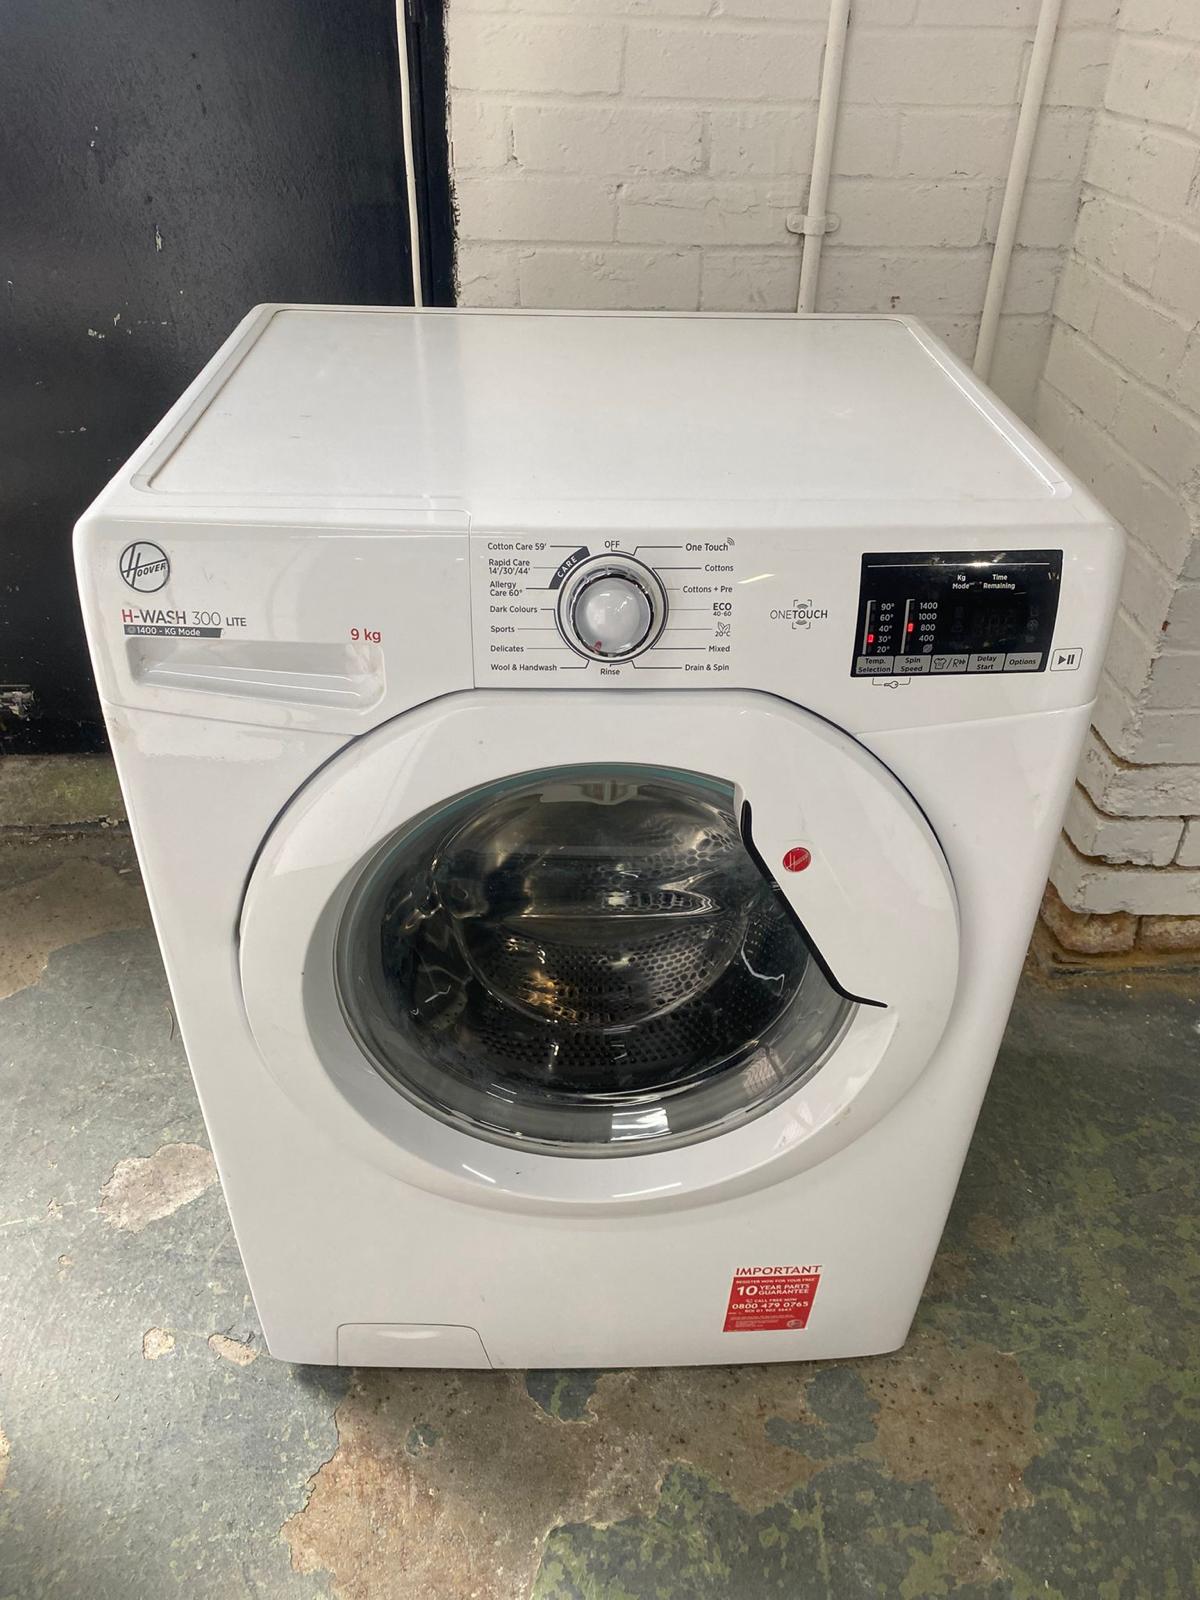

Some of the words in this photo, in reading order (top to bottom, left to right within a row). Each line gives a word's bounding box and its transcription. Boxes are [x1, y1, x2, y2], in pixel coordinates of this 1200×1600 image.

[487, 543, 513, 551] Cotton
[515, 543, 534, 551] Care
[685, 543, 700, 551] One
[702, 543, 729, 551] Touch
[489, 559, 511, 568] Rapid
[557, 555, 577, 578] CARE
[705, 564, 734, 572] Cottons
[957, 574, 966, 582] Kg
[992, 573, 1008, 581] Time
[489, 581, 517, 590] Allergy
[683, 585, 712, 593] Cottons
[720, 585, 733, 593] Pre
[983, 582, 1016, 591] Remaining
[509, 605, 538, 613] Colours
[713, 603, 732, 611] ECO
[920, 602, 938, 610] 1400
[122, 609, 186, 625] H-WASH
[192, 611, 221, 626] 300
[226, 617, 247, 626] LITE
[137, 626, 157, 635] 1400
[490, 625, 515, 634] Sports
[351, 628, 359, 641] 9
[364, 629, 382, 643] kg
[977, 655, 997, 663] Delay
[1009, 658, 1037, 666] Options
[600, 668, 620, 676] Rinse
[713, 664, 730, 673] Spin
[736, 1265, 822, 1275] IMPORTANT
[737, 1285, 758, 1296] 10
